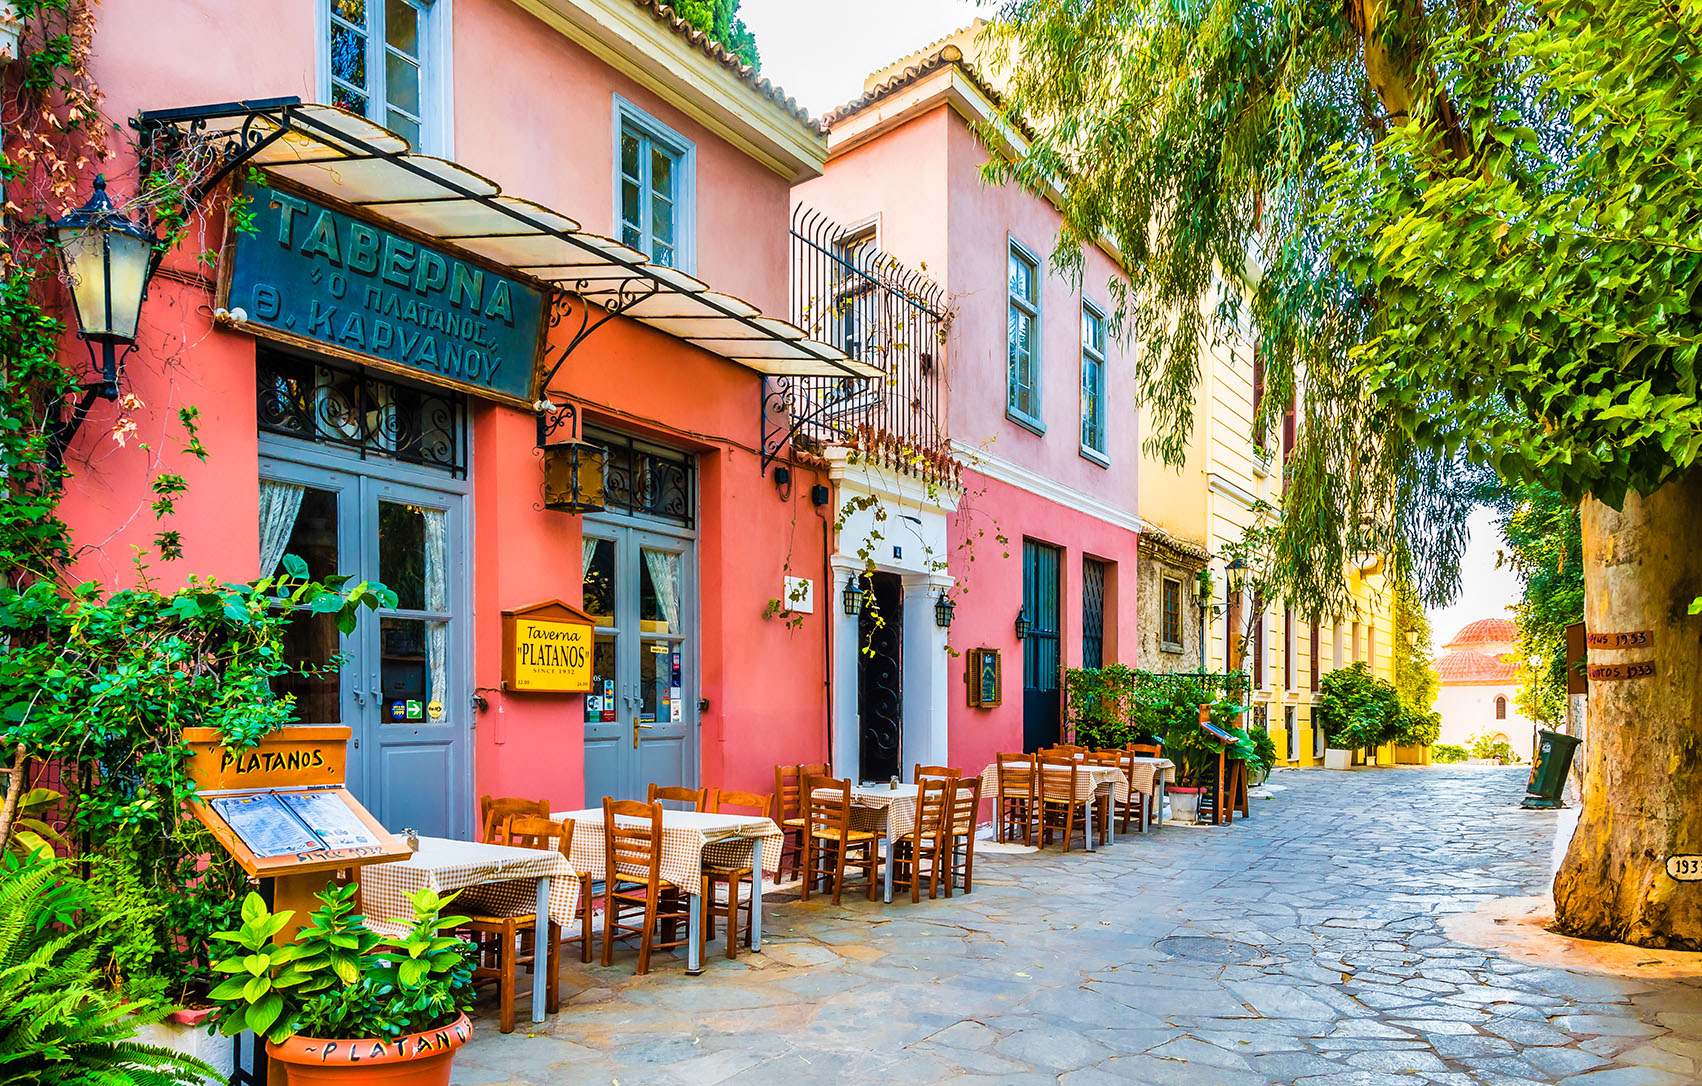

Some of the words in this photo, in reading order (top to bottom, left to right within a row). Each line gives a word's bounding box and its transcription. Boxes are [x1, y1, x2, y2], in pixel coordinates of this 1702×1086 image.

[270, 190, 514, 328] ΤΑΒΕΡΝΑ
[308, 299, 502, 386] ΚΑΡΥΑΝΟΥ
[527, 626, 582, 642] Taverna
[1616, 632, 1648, 647] 1933
[1676, 859, 1702, 874] 193
